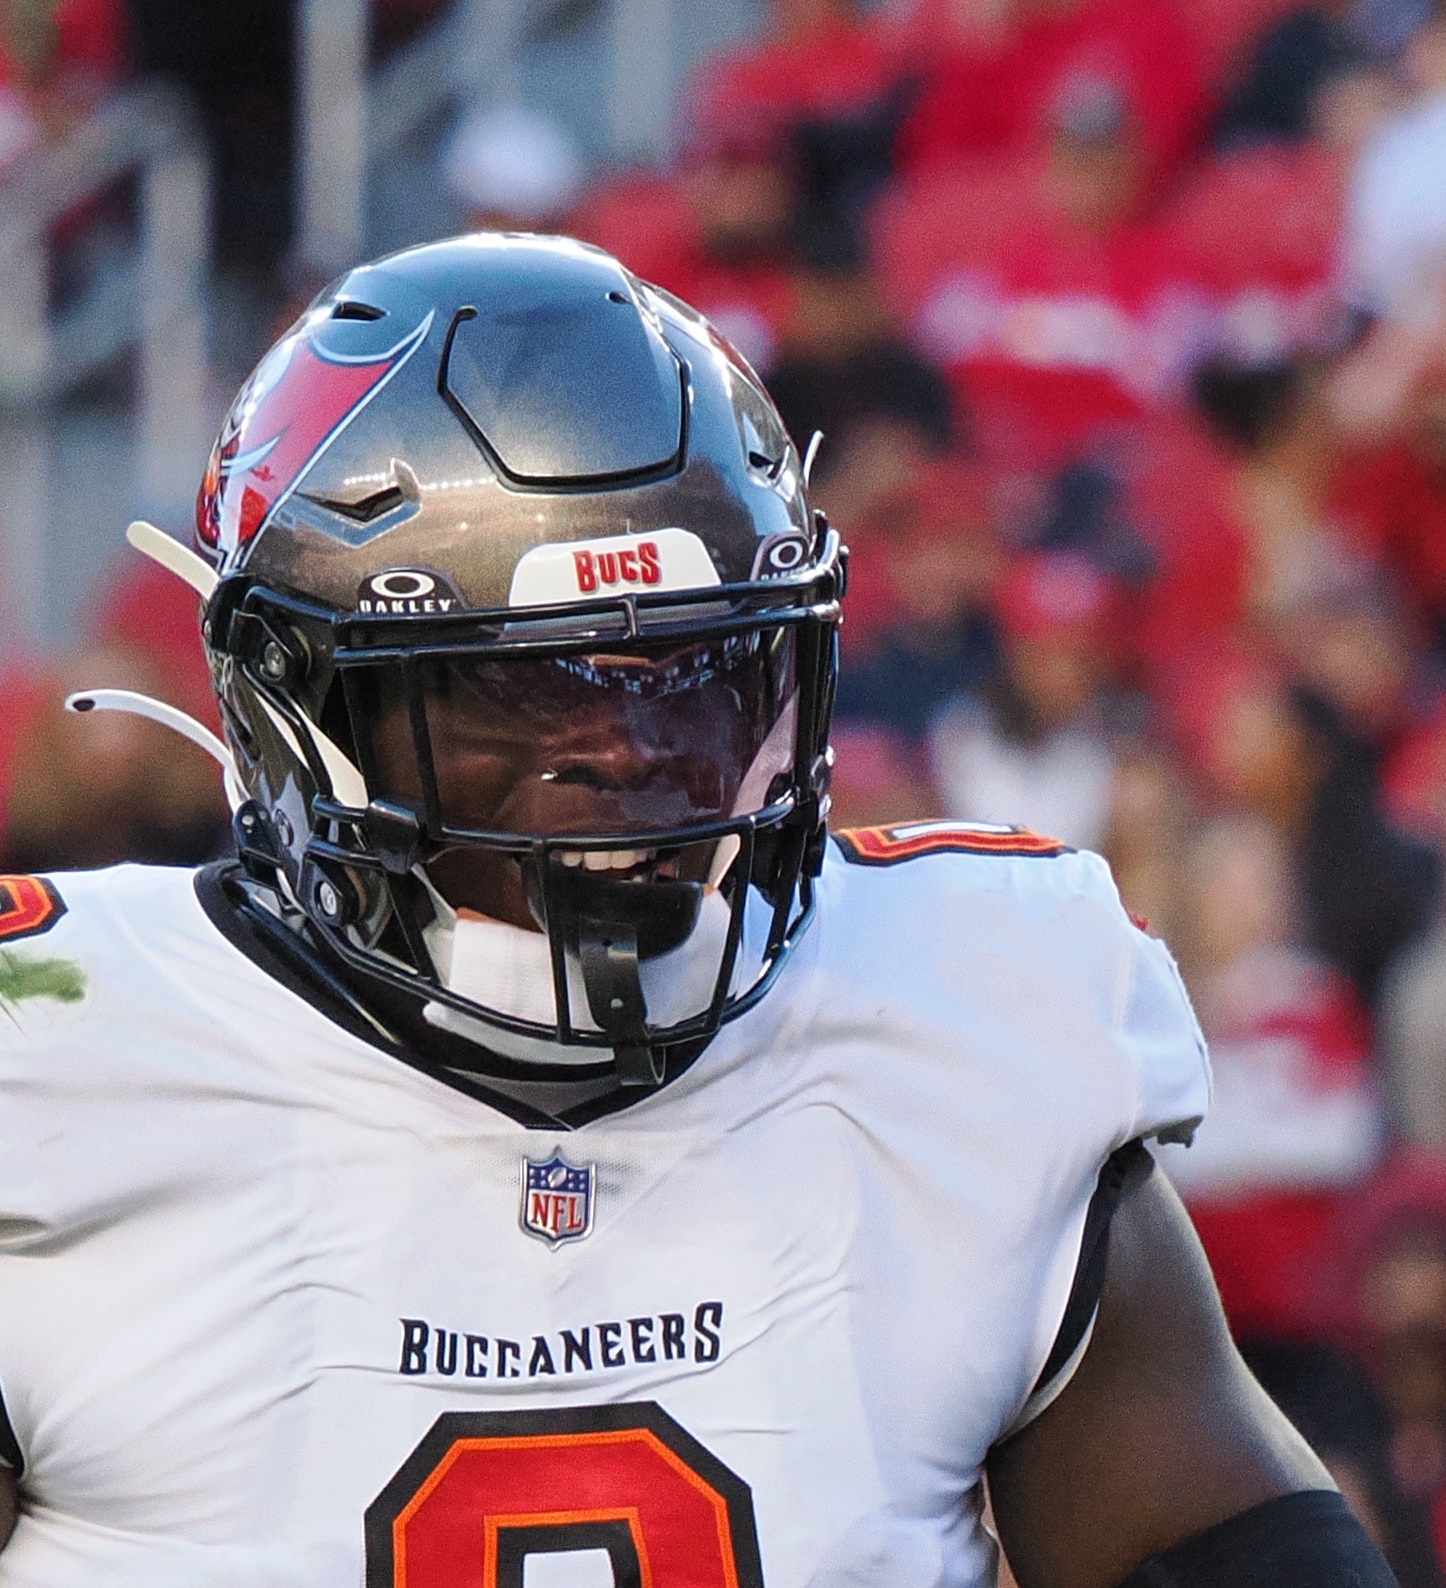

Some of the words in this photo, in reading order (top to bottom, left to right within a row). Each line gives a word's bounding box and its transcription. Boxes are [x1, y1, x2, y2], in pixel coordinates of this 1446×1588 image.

[572, 542, 661, 592] BUCS
[359, 599, 452, 613] OAKLEY
[529, 1192, 583, 1233] NFL
[398, 1301, 723, 1378] BUCCANEERS
